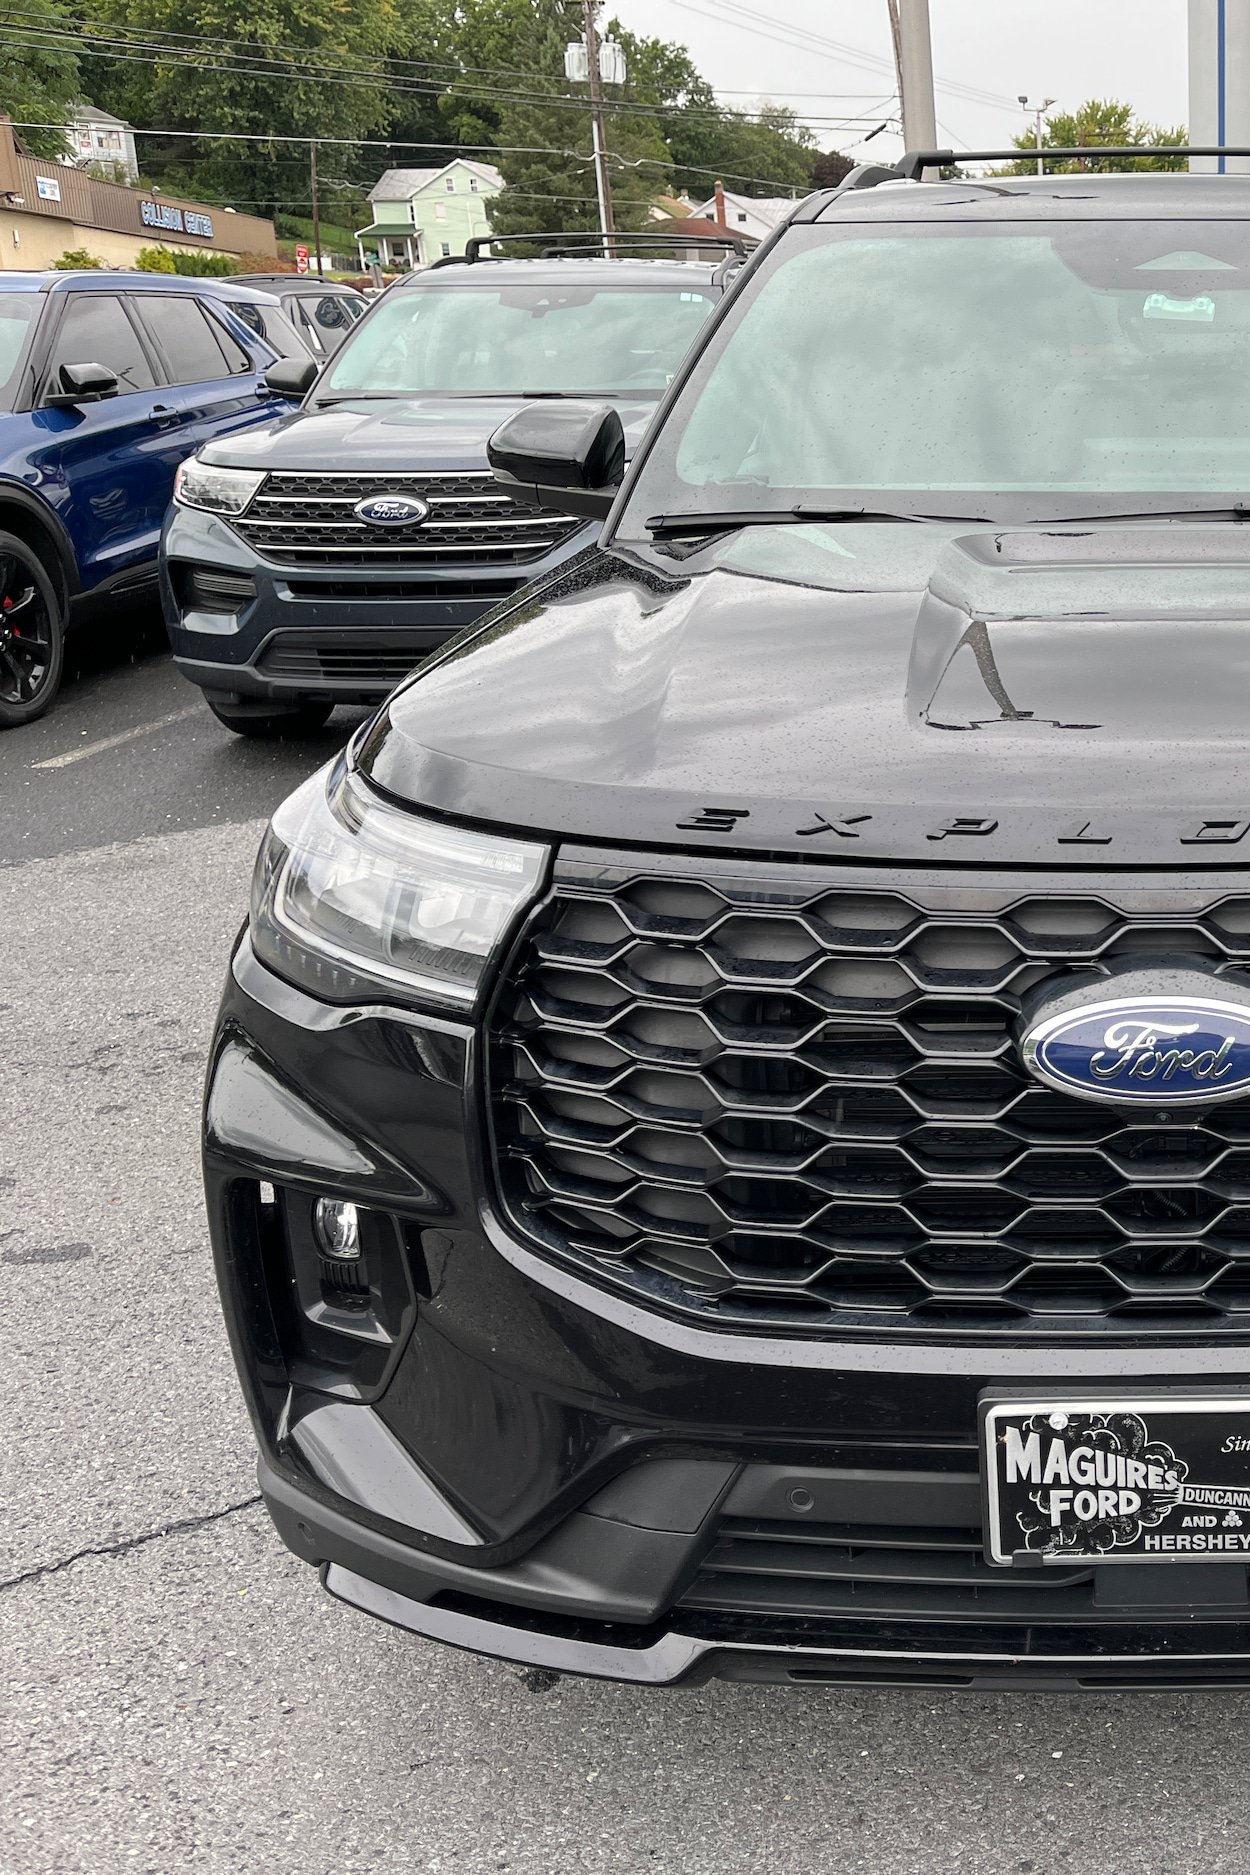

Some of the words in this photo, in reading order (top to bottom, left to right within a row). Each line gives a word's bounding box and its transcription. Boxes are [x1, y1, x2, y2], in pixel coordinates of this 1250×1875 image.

[141, 200, 184, 231] COLLISION
[184, 210, 214, 237] CENTER
[371, 502, 409, 518] Ford
[1089, 1020, 1236, 1081] Ford
[1049, 1489, 1142, 1527] FORD
[1181, 1516, 1218, 1528] AND
